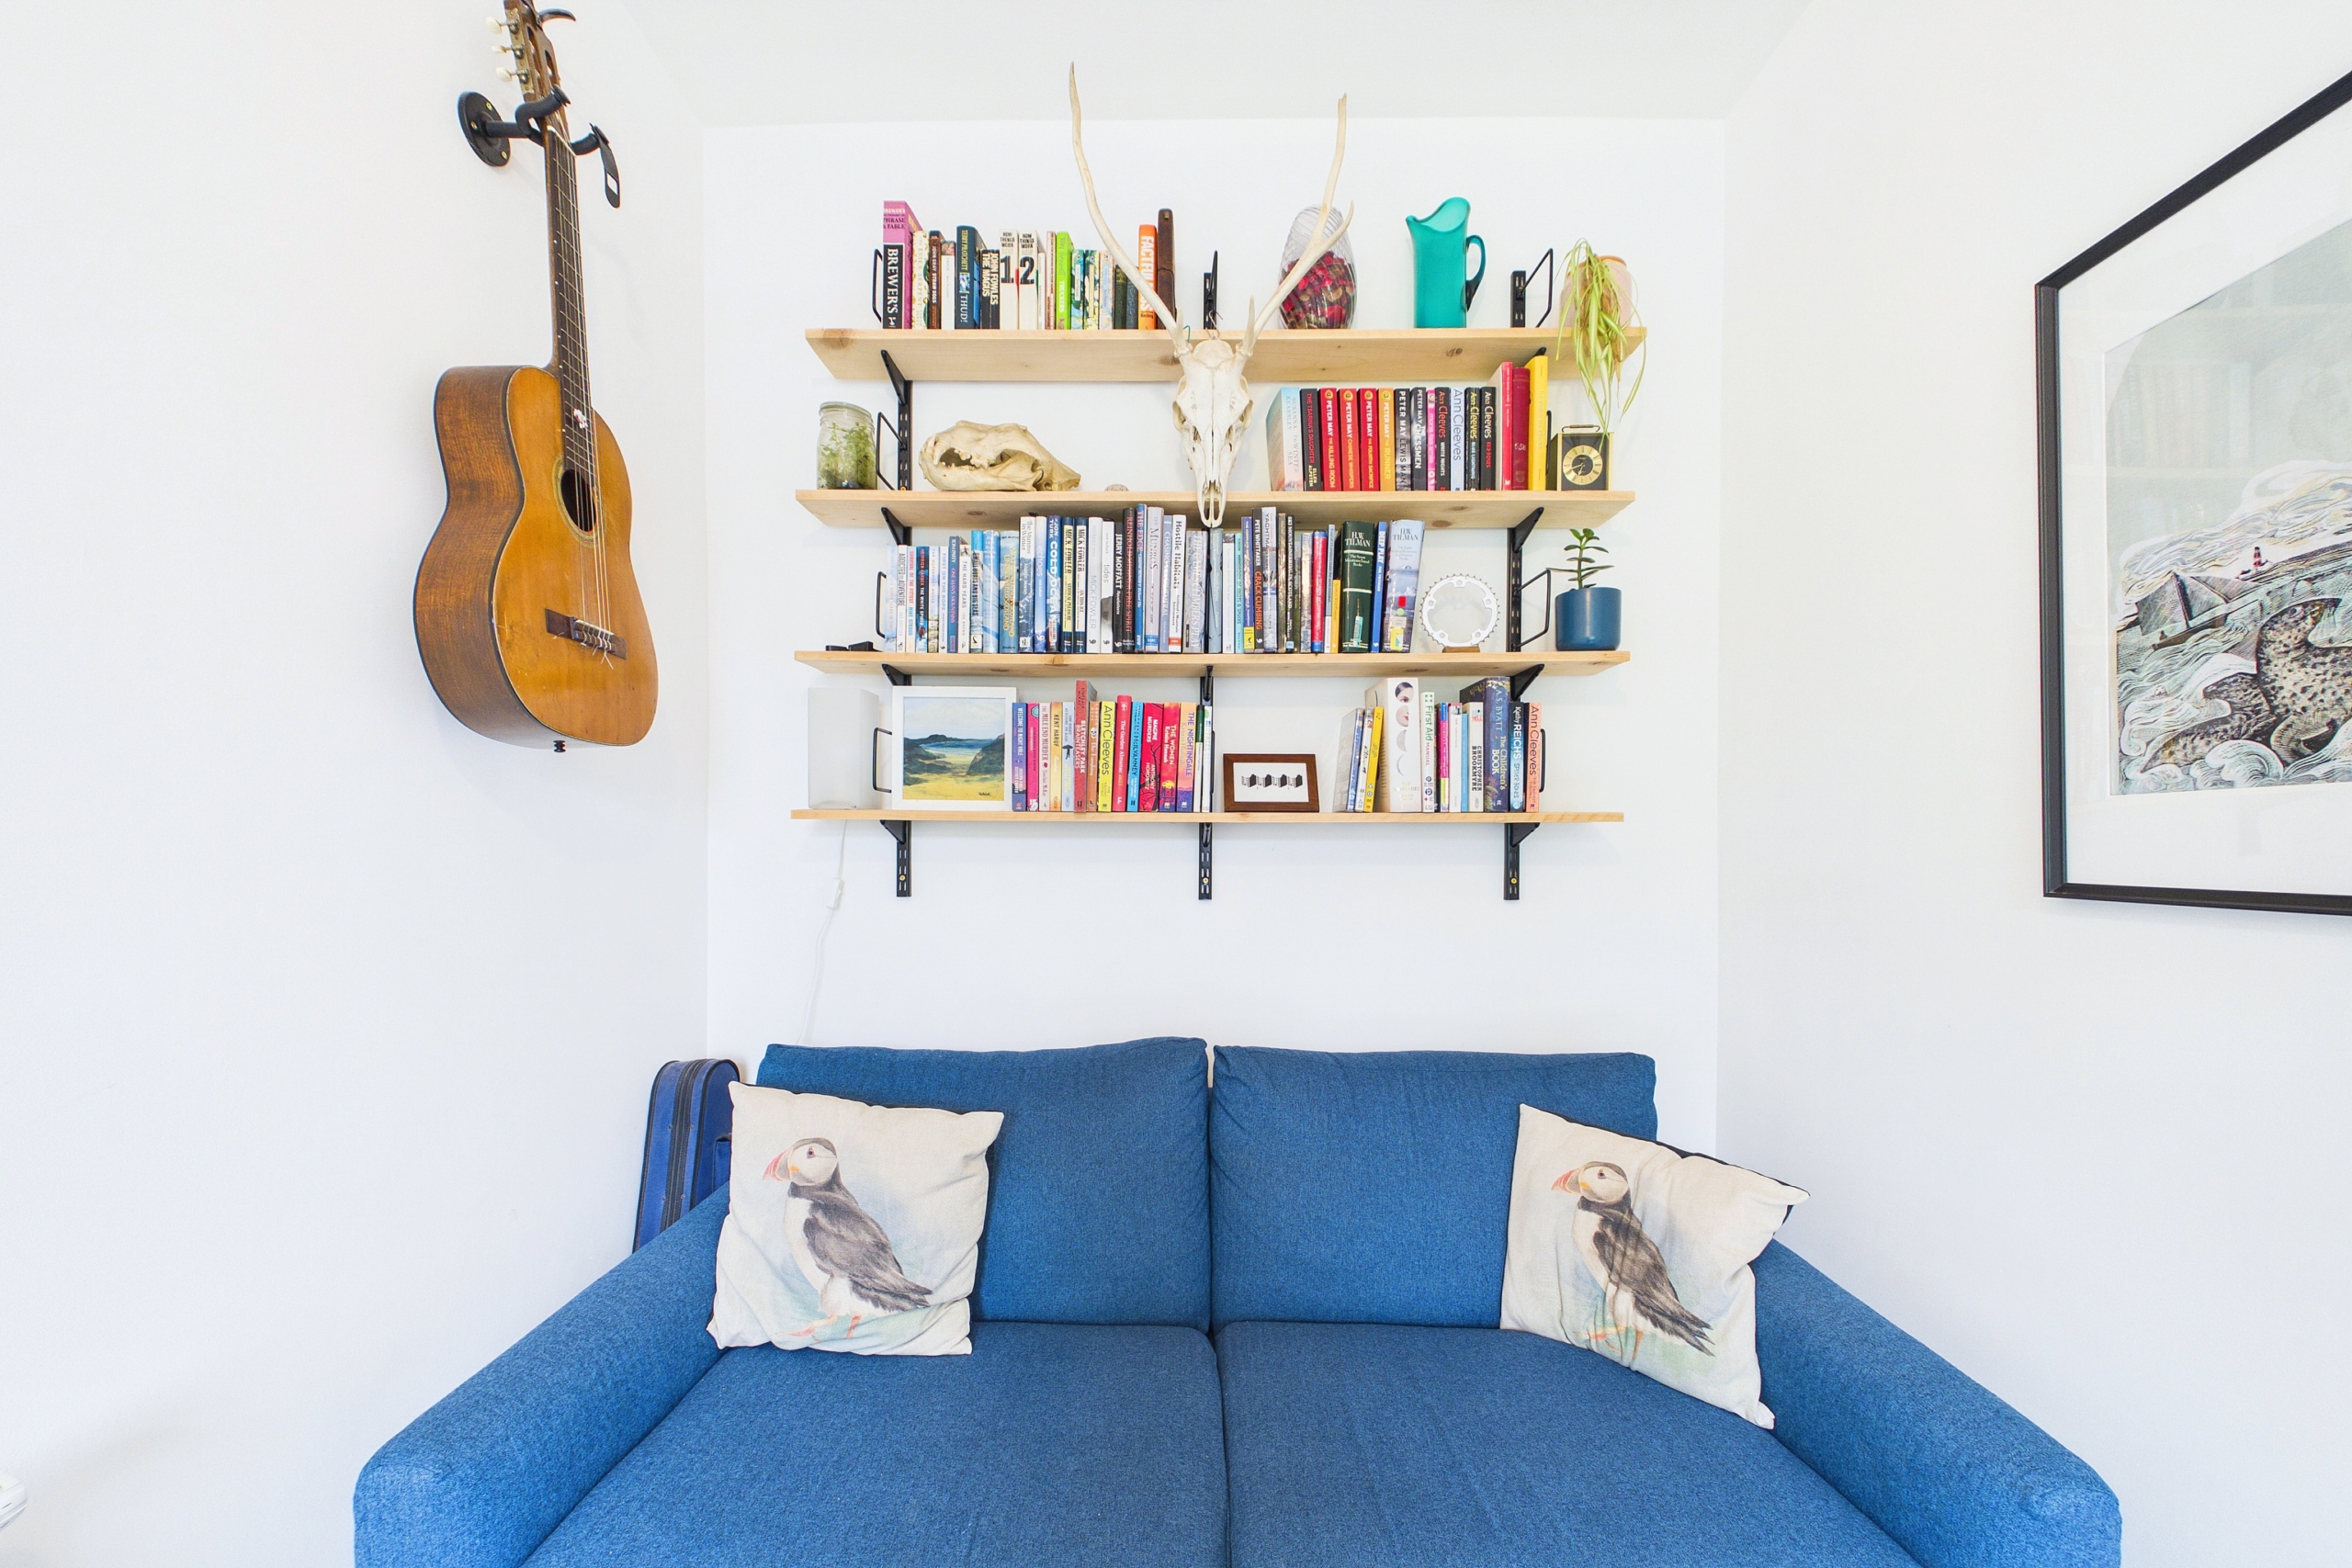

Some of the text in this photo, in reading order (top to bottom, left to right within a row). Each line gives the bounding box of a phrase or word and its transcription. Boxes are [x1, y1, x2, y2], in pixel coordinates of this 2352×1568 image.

[960, 229, 969, 272] TERRY PRATCHETT
[887, 249, 900, 314] BREWER'S
[982, 252, 991, 297] THE MAGUS
[1439, 406, 1448, 439] Cleeves
[1453, 389, 1464, 462] Ann Cleeves
[1470, 407, 1479, 439] Cleeves
[1484, 406, 1494, 439] Cleeves
[1035, 545, 1045, 577] echoes
[1049, 541, 1058, 574] COLD
[1064, 529, 1072, 574] MICK FOWLER
[1172, 521, 1183, 589] Hostile Habitats
[1344, 538, 1371, 547] TILMAN
[898, 554, 906, 575] ADDICTED
[942, 571, 947, 580] ON
[1190, 583, 1202, 649] CLIMBERS PLAY
[1425, 705, 1434, 725] First
[1425, 727, 1434, 742] Aid
[1513, 706, 1522, 759] Kathy REICHS
[1102, 705, 1113, 775] Ann Cleeves
[1131, 735, 1140, 777] McILVANNEY
[1184, 729, 1194, 777] NIGHTINGALE
[1529, 705, 1539, 776] Ann Cleeves
[1498, 748, 1507, 791] Children's
